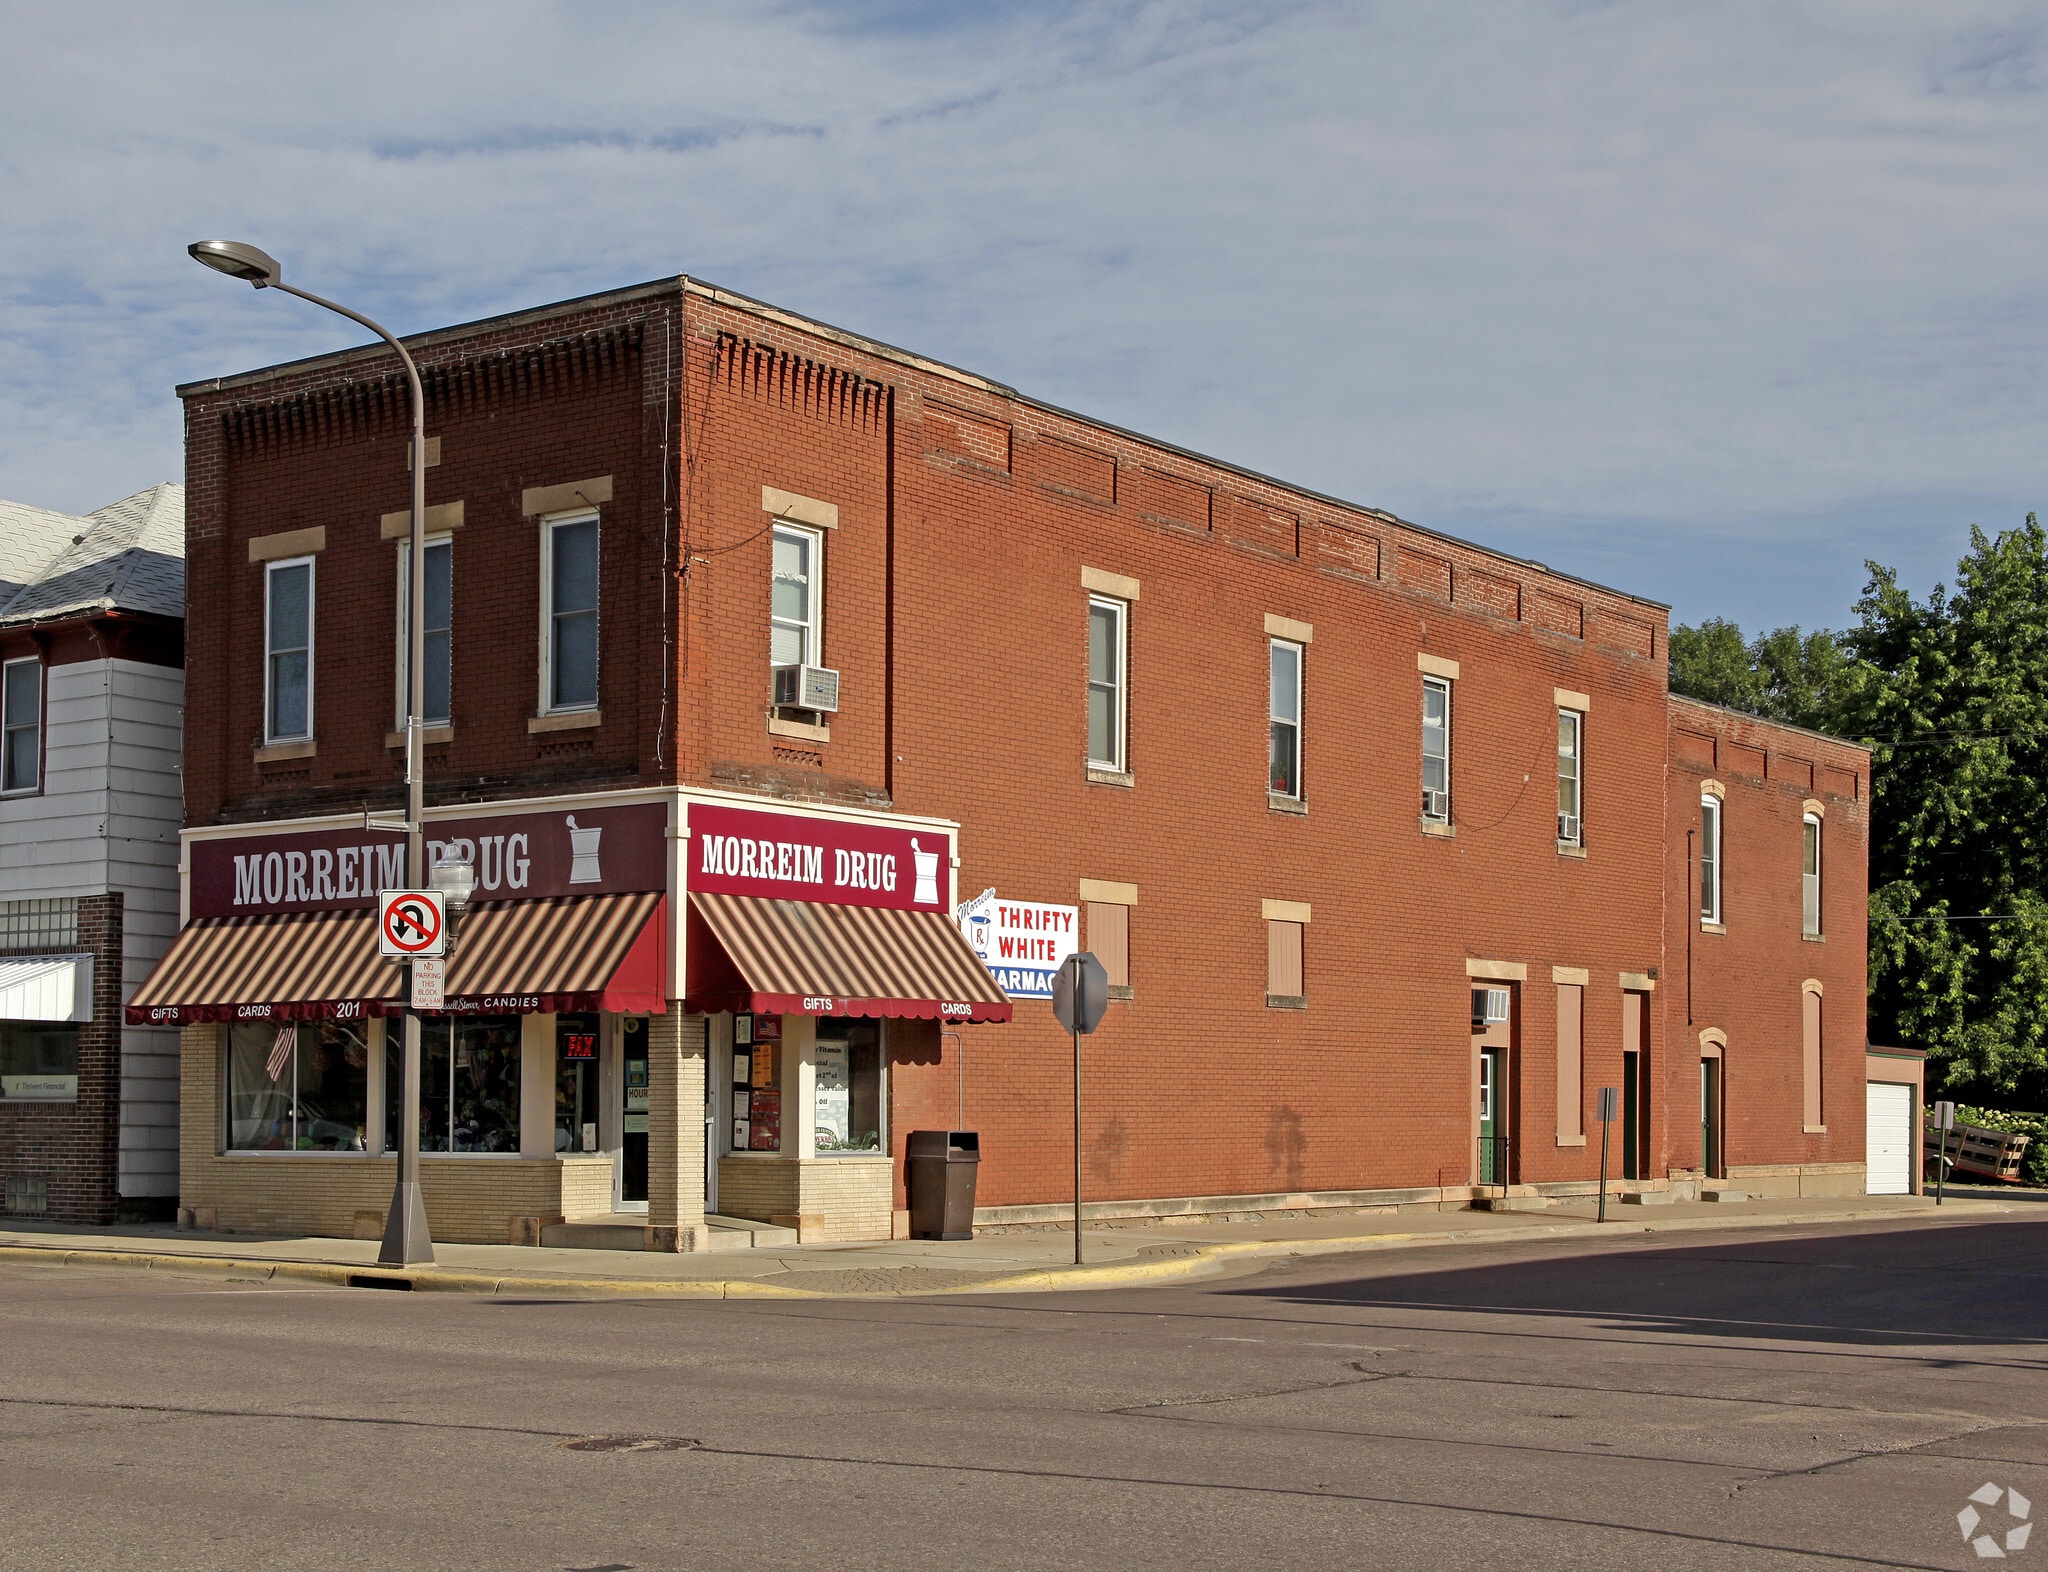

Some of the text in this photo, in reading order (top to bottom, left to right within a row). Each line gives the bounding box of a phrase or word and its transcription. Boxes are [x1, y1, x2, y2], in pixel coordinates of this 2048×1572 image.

[701, 834, 897, 892] MORREIM DRUG
[233, 842, 405, 906] MORREIM
[957, 888, 995, 920] Morreim
[999, 906, 1072, 932] THRIFTY
[998, 936, 1055, 961] WHITE
[990, 969, 1056, 992] ARMAC
[238, 1005, 271, 1018] CARDS
[336, 1001, 360, 1019] 201
[484, 997, 539, 1007] CANDIES
[803, 997, 833, 1010] GIFTS
[941, 1002, 972, 1016] CARDS
[151, 1007, 178, 1020] GIFTS
[567, 1036, 593, 1056] FAX
